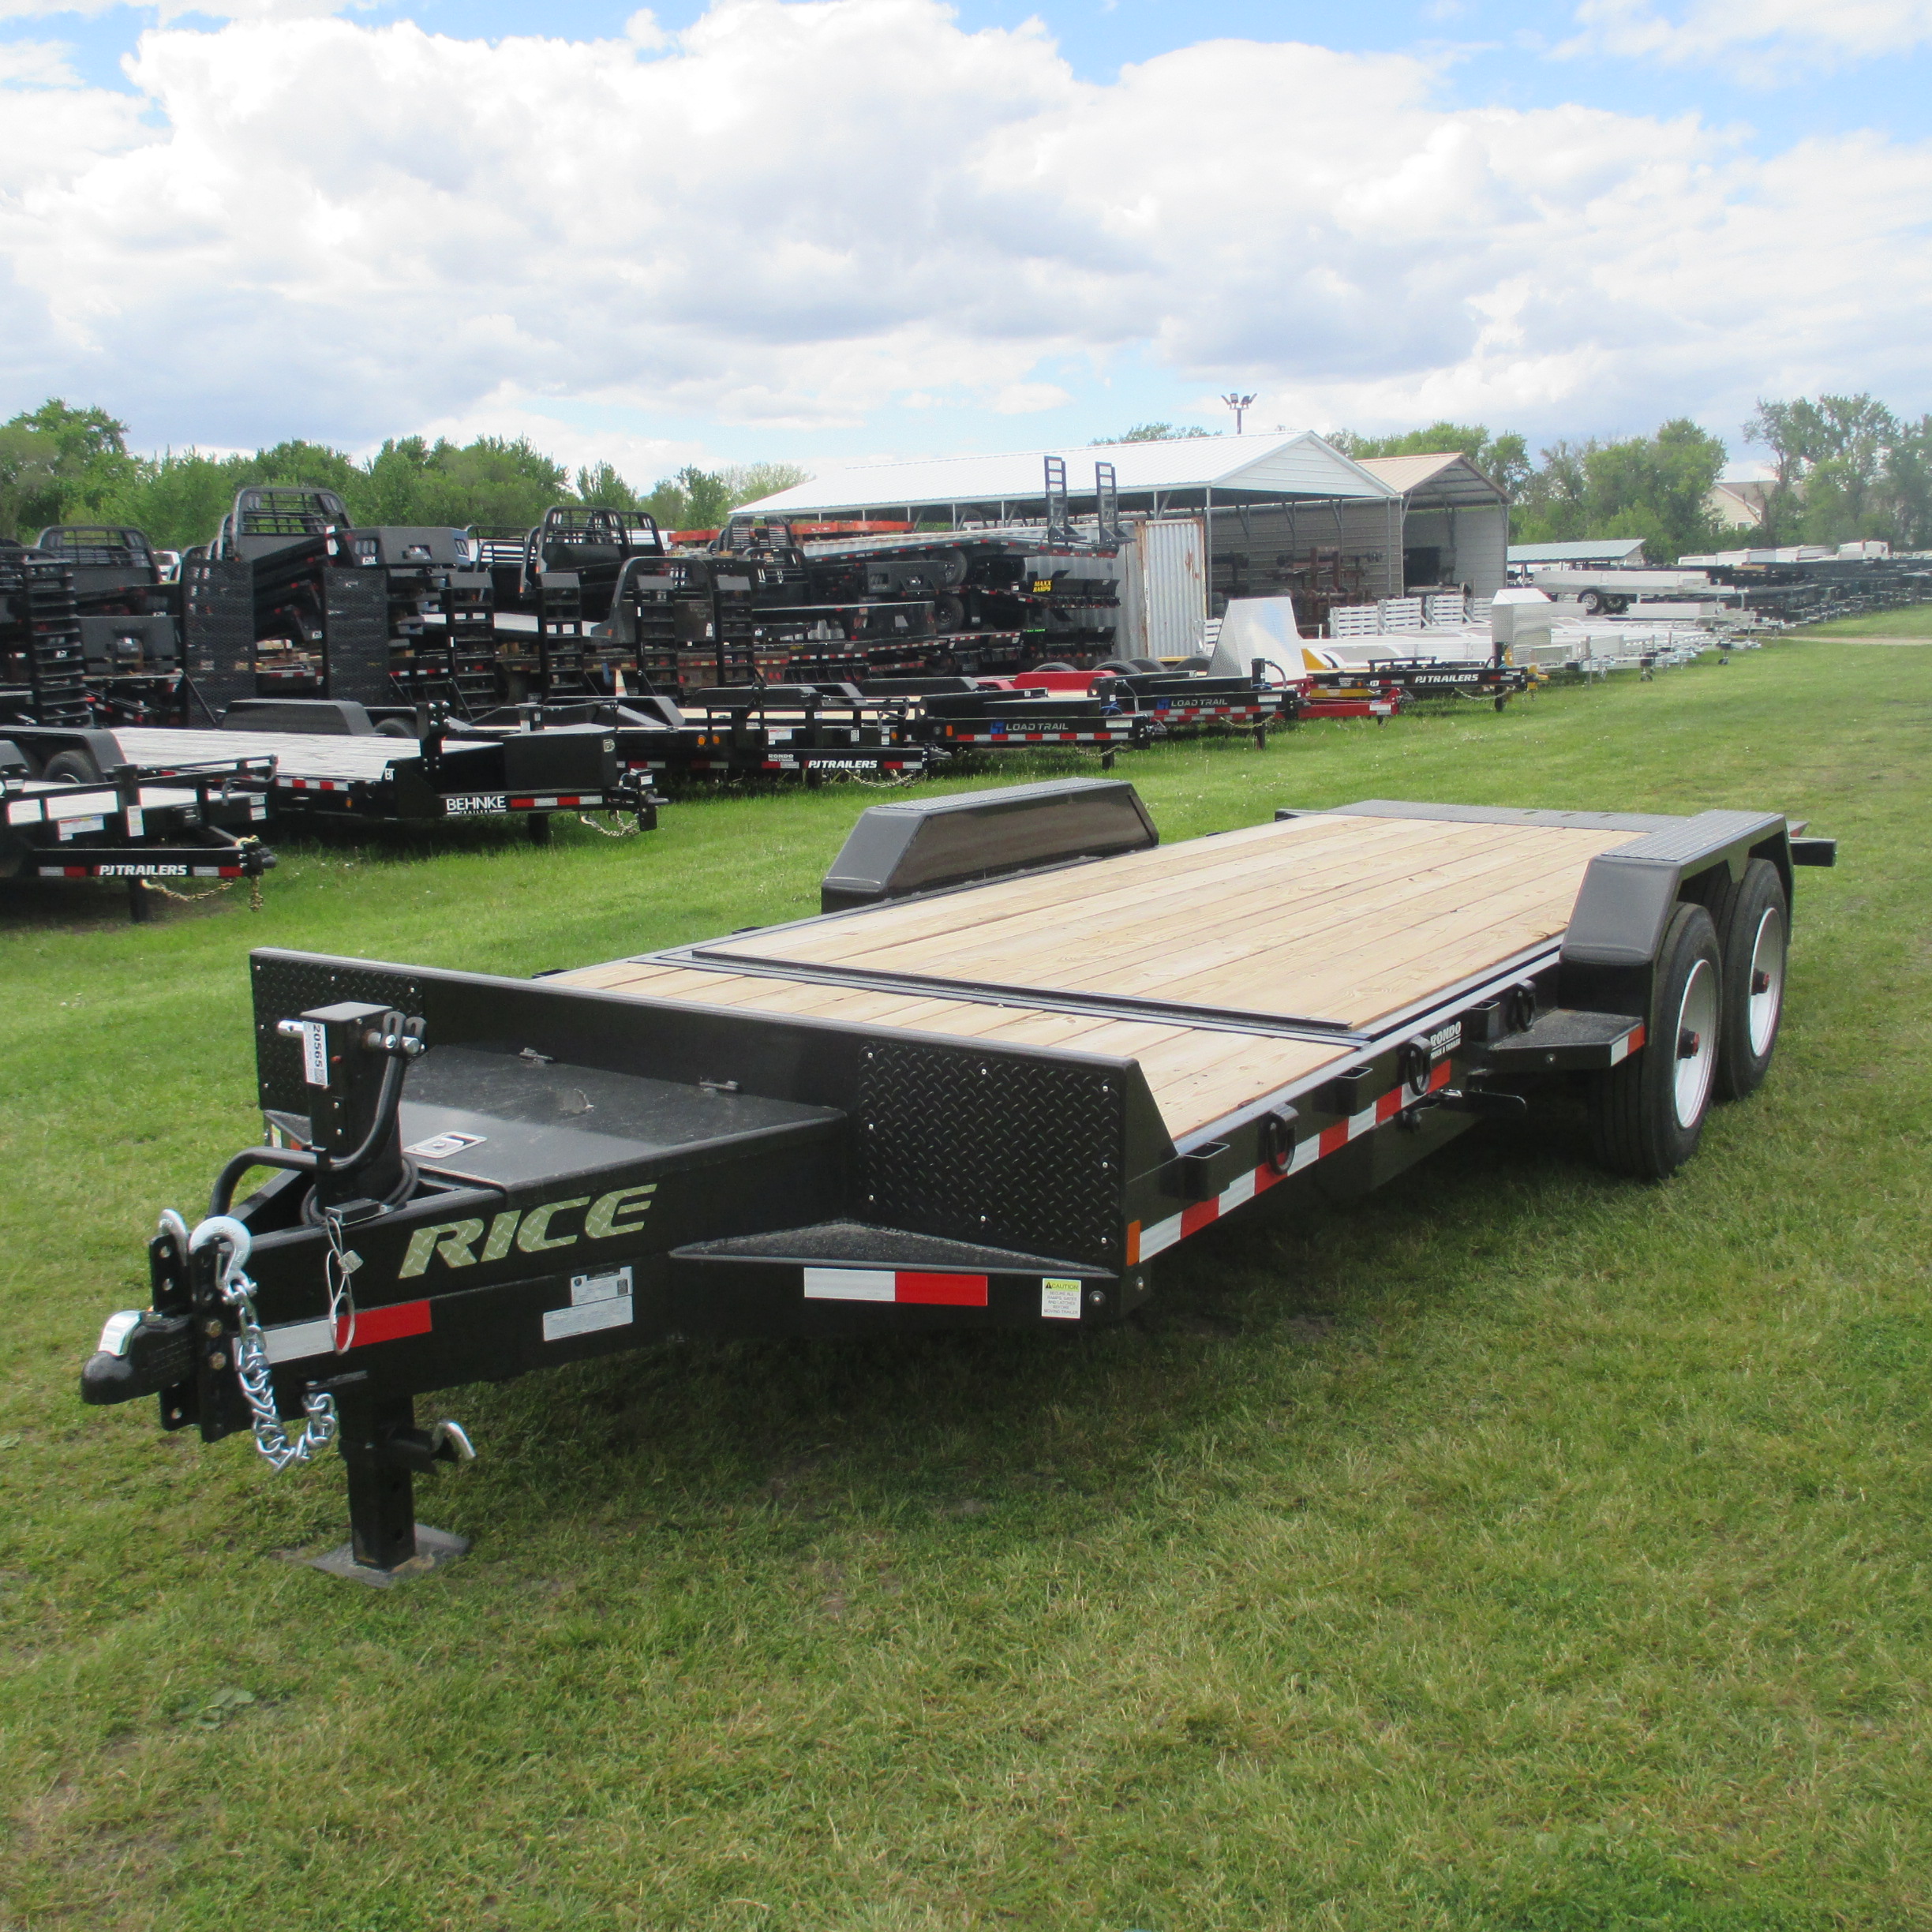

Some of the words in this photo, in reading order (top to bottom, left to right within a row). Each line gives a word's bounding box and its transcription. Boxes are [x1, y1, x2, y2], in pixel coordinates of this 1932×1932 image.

[1427, 673, 1479, 683] TRAILERS
[1039, 722, 1069, 731] TRAIL
[807, 760, 822, 769] PJ
[822, 760, 878, 769] TRAILERS
[446, 796, 507, 811] BEHNKE
[99, 865, 115, 876] PJ
[116, 864, 187, 876] TRAILERS
[1430, 1020, 1462, 1046] RONDO
[313, 1024, 323, 1068] 20565
[398, 1184, 657, 1279] RICE
